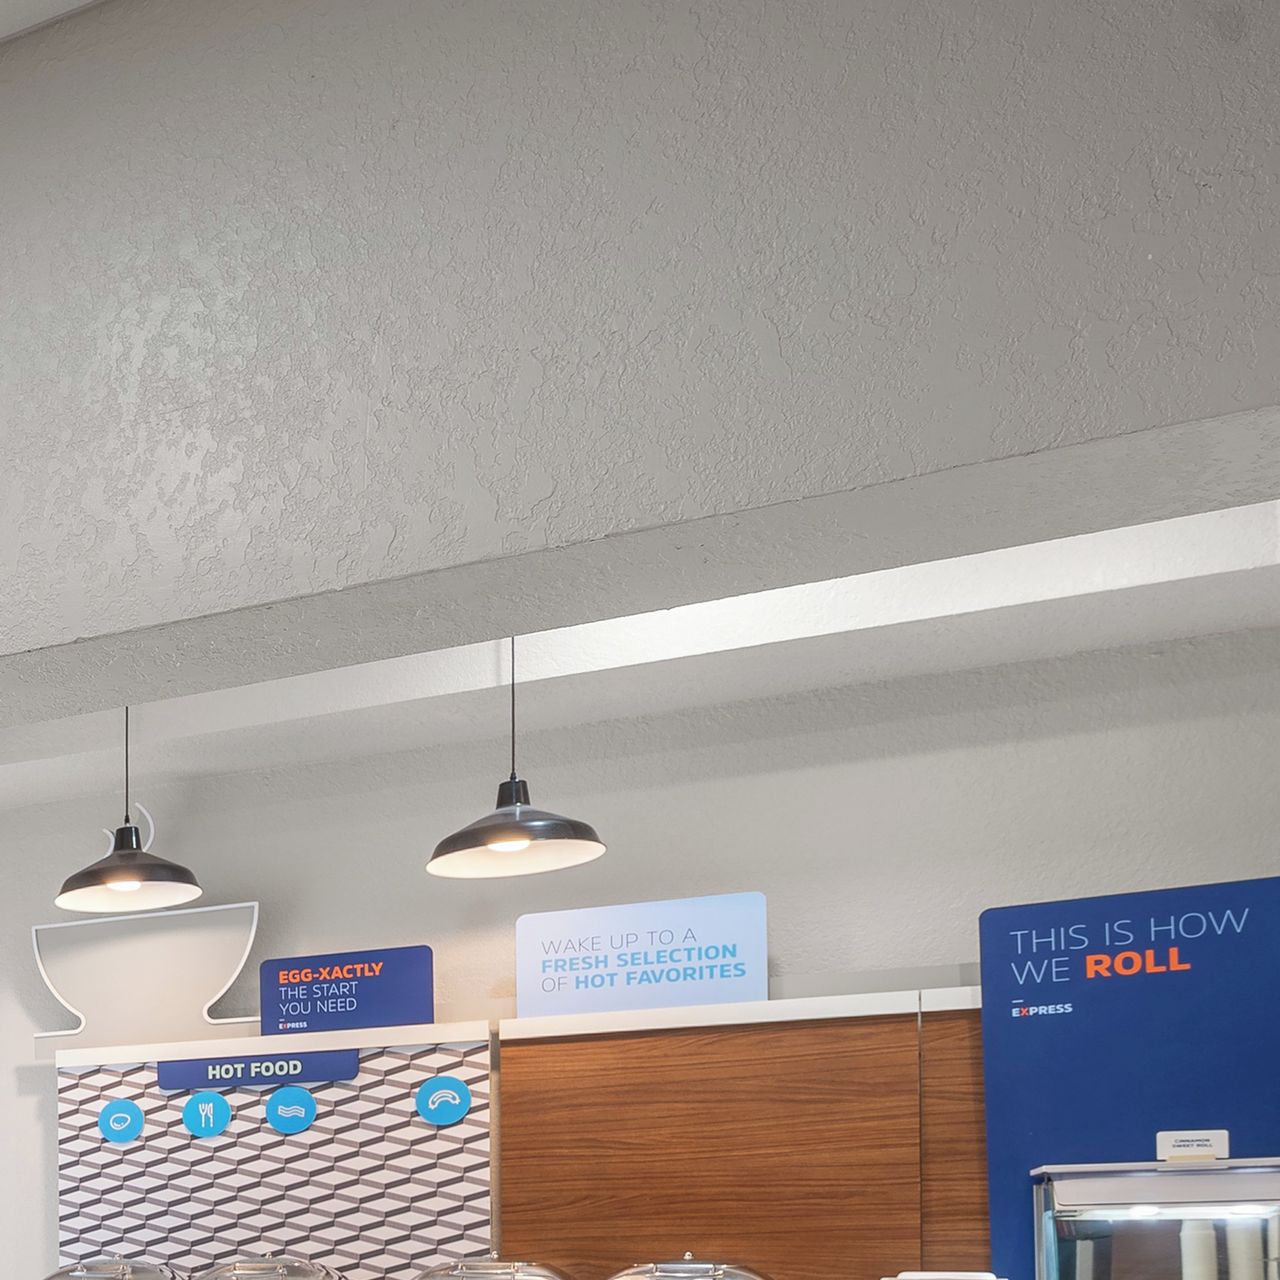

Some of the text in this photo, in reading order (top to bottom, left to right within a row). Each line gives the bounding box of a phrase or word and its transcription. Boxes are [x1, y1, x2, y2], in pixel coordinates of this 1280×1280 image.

[541, 927, 697, 955] WAKE UP TO A
[1009, 908, 1249, 954] THIS IS HOW
[541, 943, 737, 974] FRESH SELECTION
[1010, 947, 1191, 985] WE ROLL
[278, 962, 384, 984] EGG-XACTLY
[541, 962, 746, 993] OF HOT FAVORITES
[279, 981, 358, 1000] THE START
[279, 997, 358, 1016] YOU NEED
[1011, 1003, 1073, 1018] EXPRESS
[207, 1060, 302, 1080] HOT FOOD
